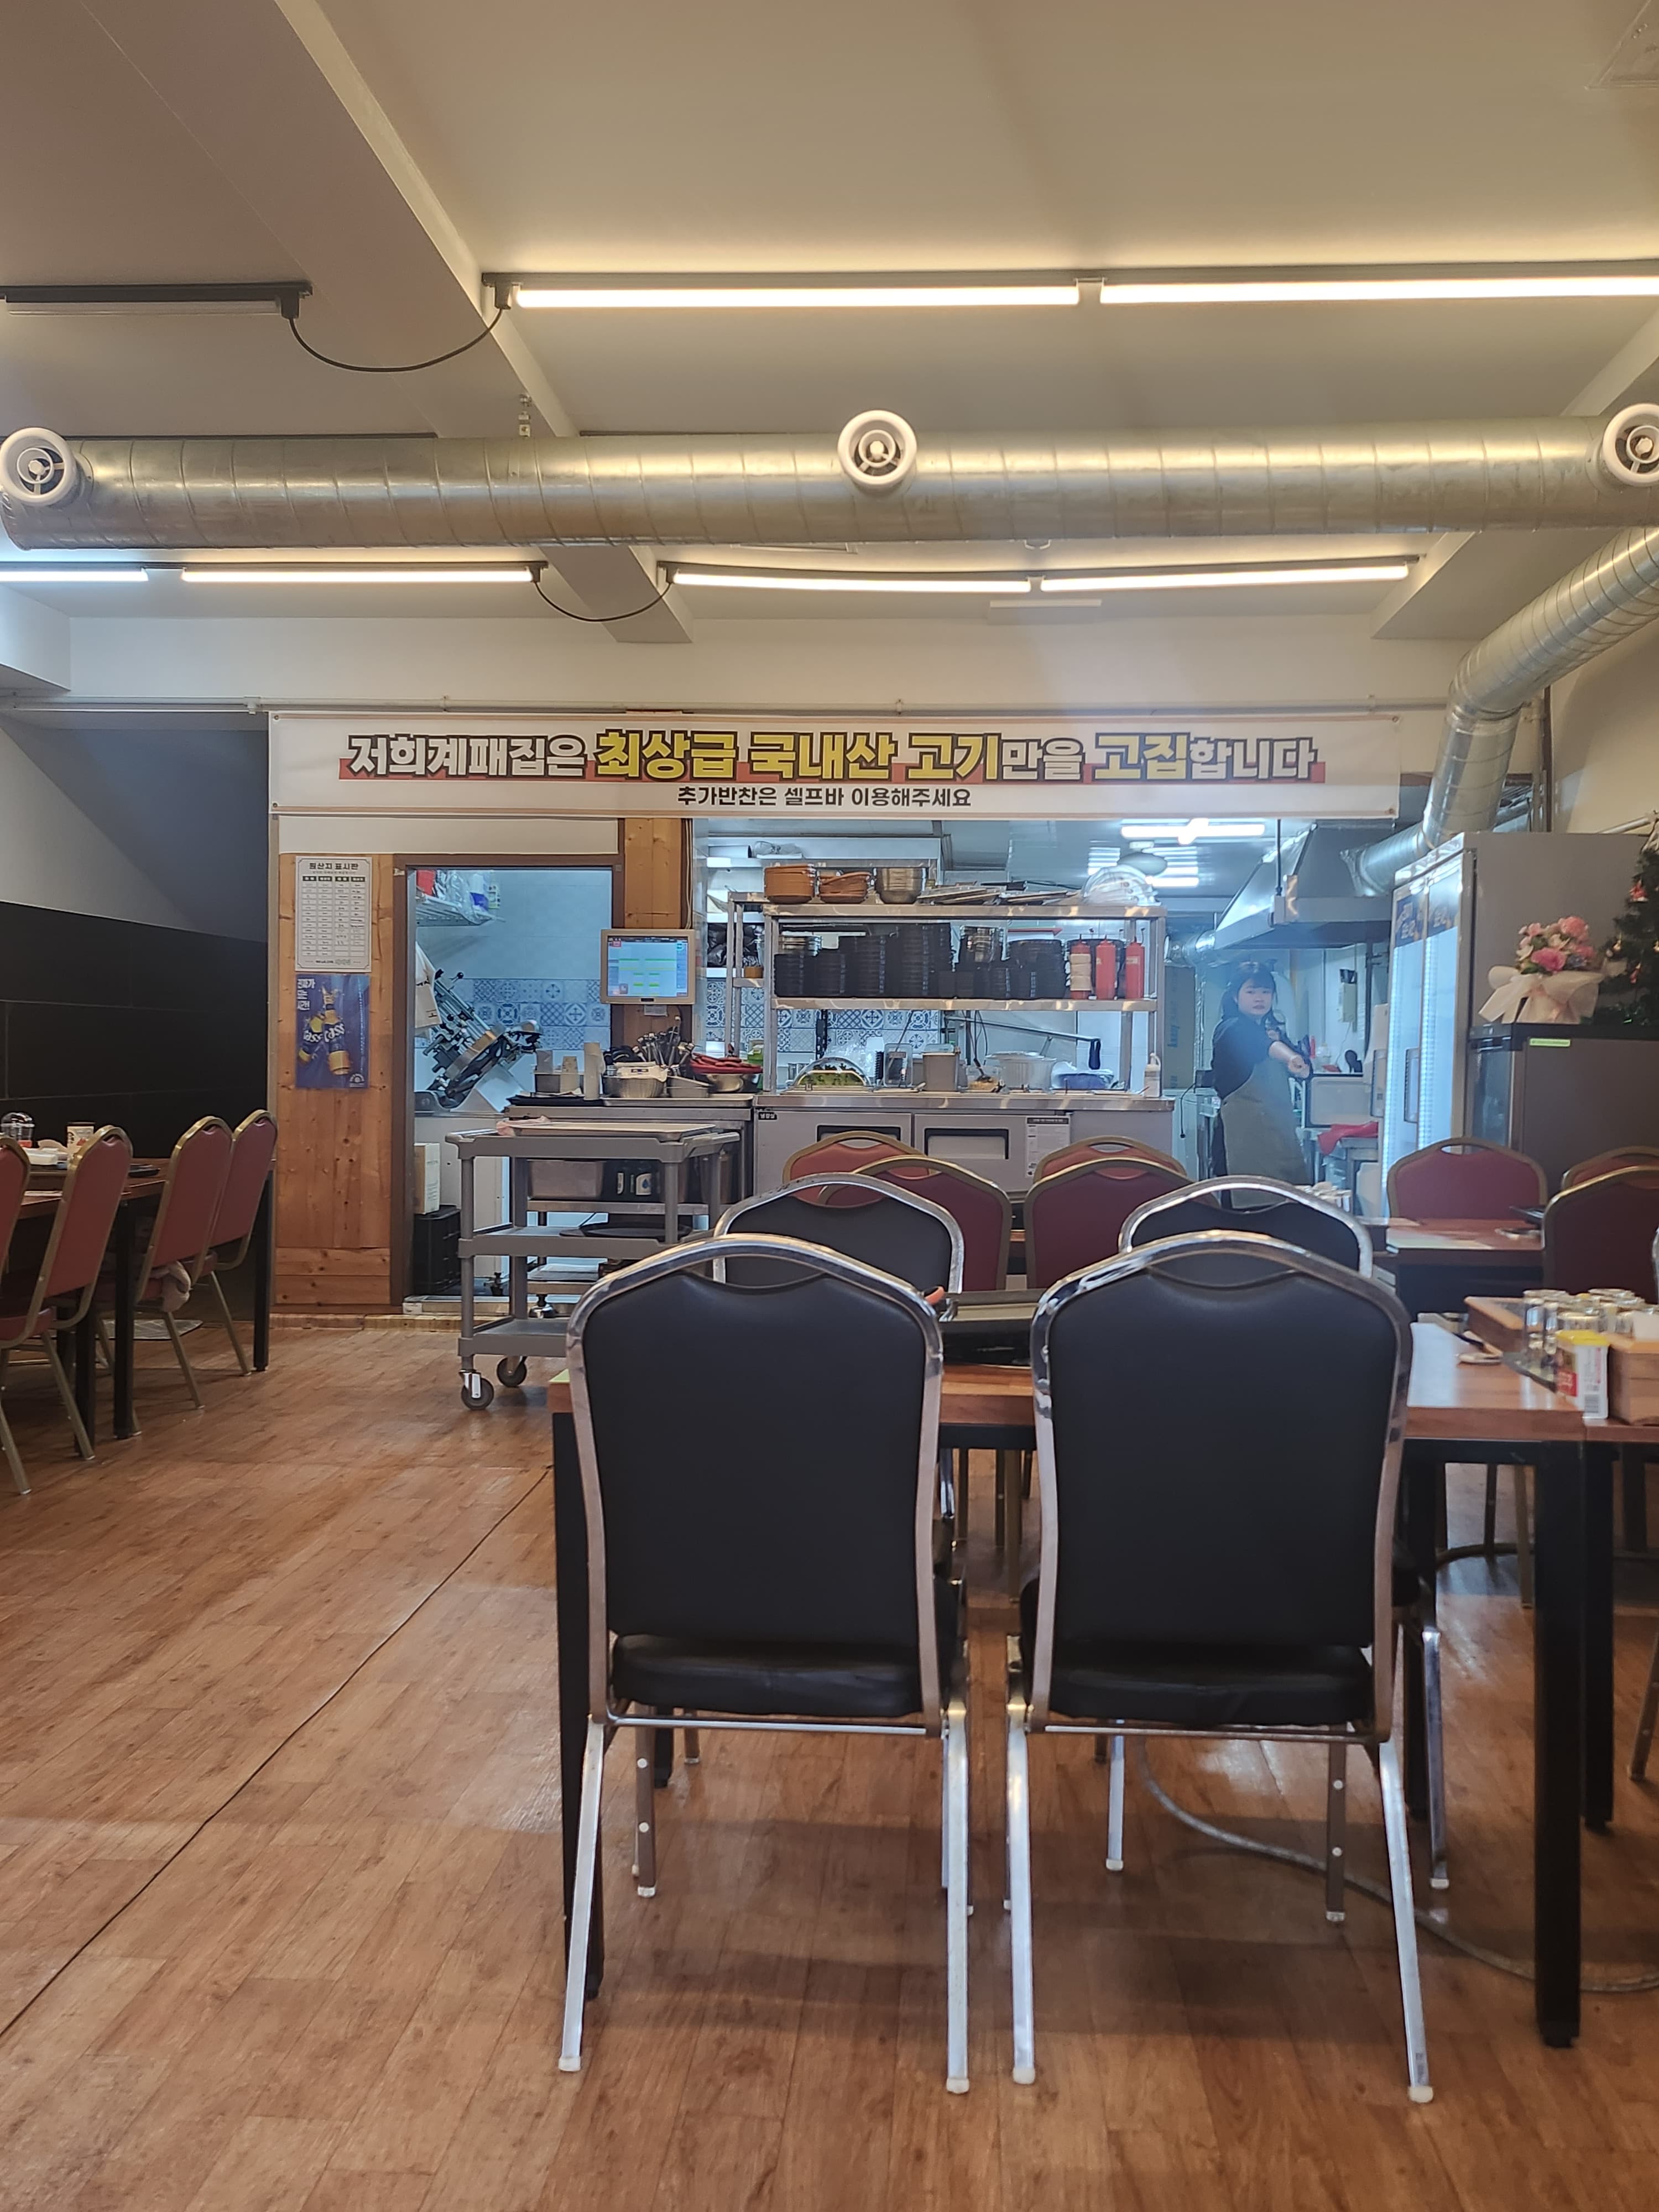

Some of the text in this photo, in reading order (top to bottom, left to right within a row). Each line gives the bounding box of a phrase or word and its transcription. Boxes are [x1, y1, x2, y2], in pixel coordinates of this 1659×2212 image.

[349, 730, 1315, 780] 저희계패집은 최상급 국내산 고기만을 고집합니다
[678, 786, 971, 807] 추가반찬은 셀프바 이용해주세요
